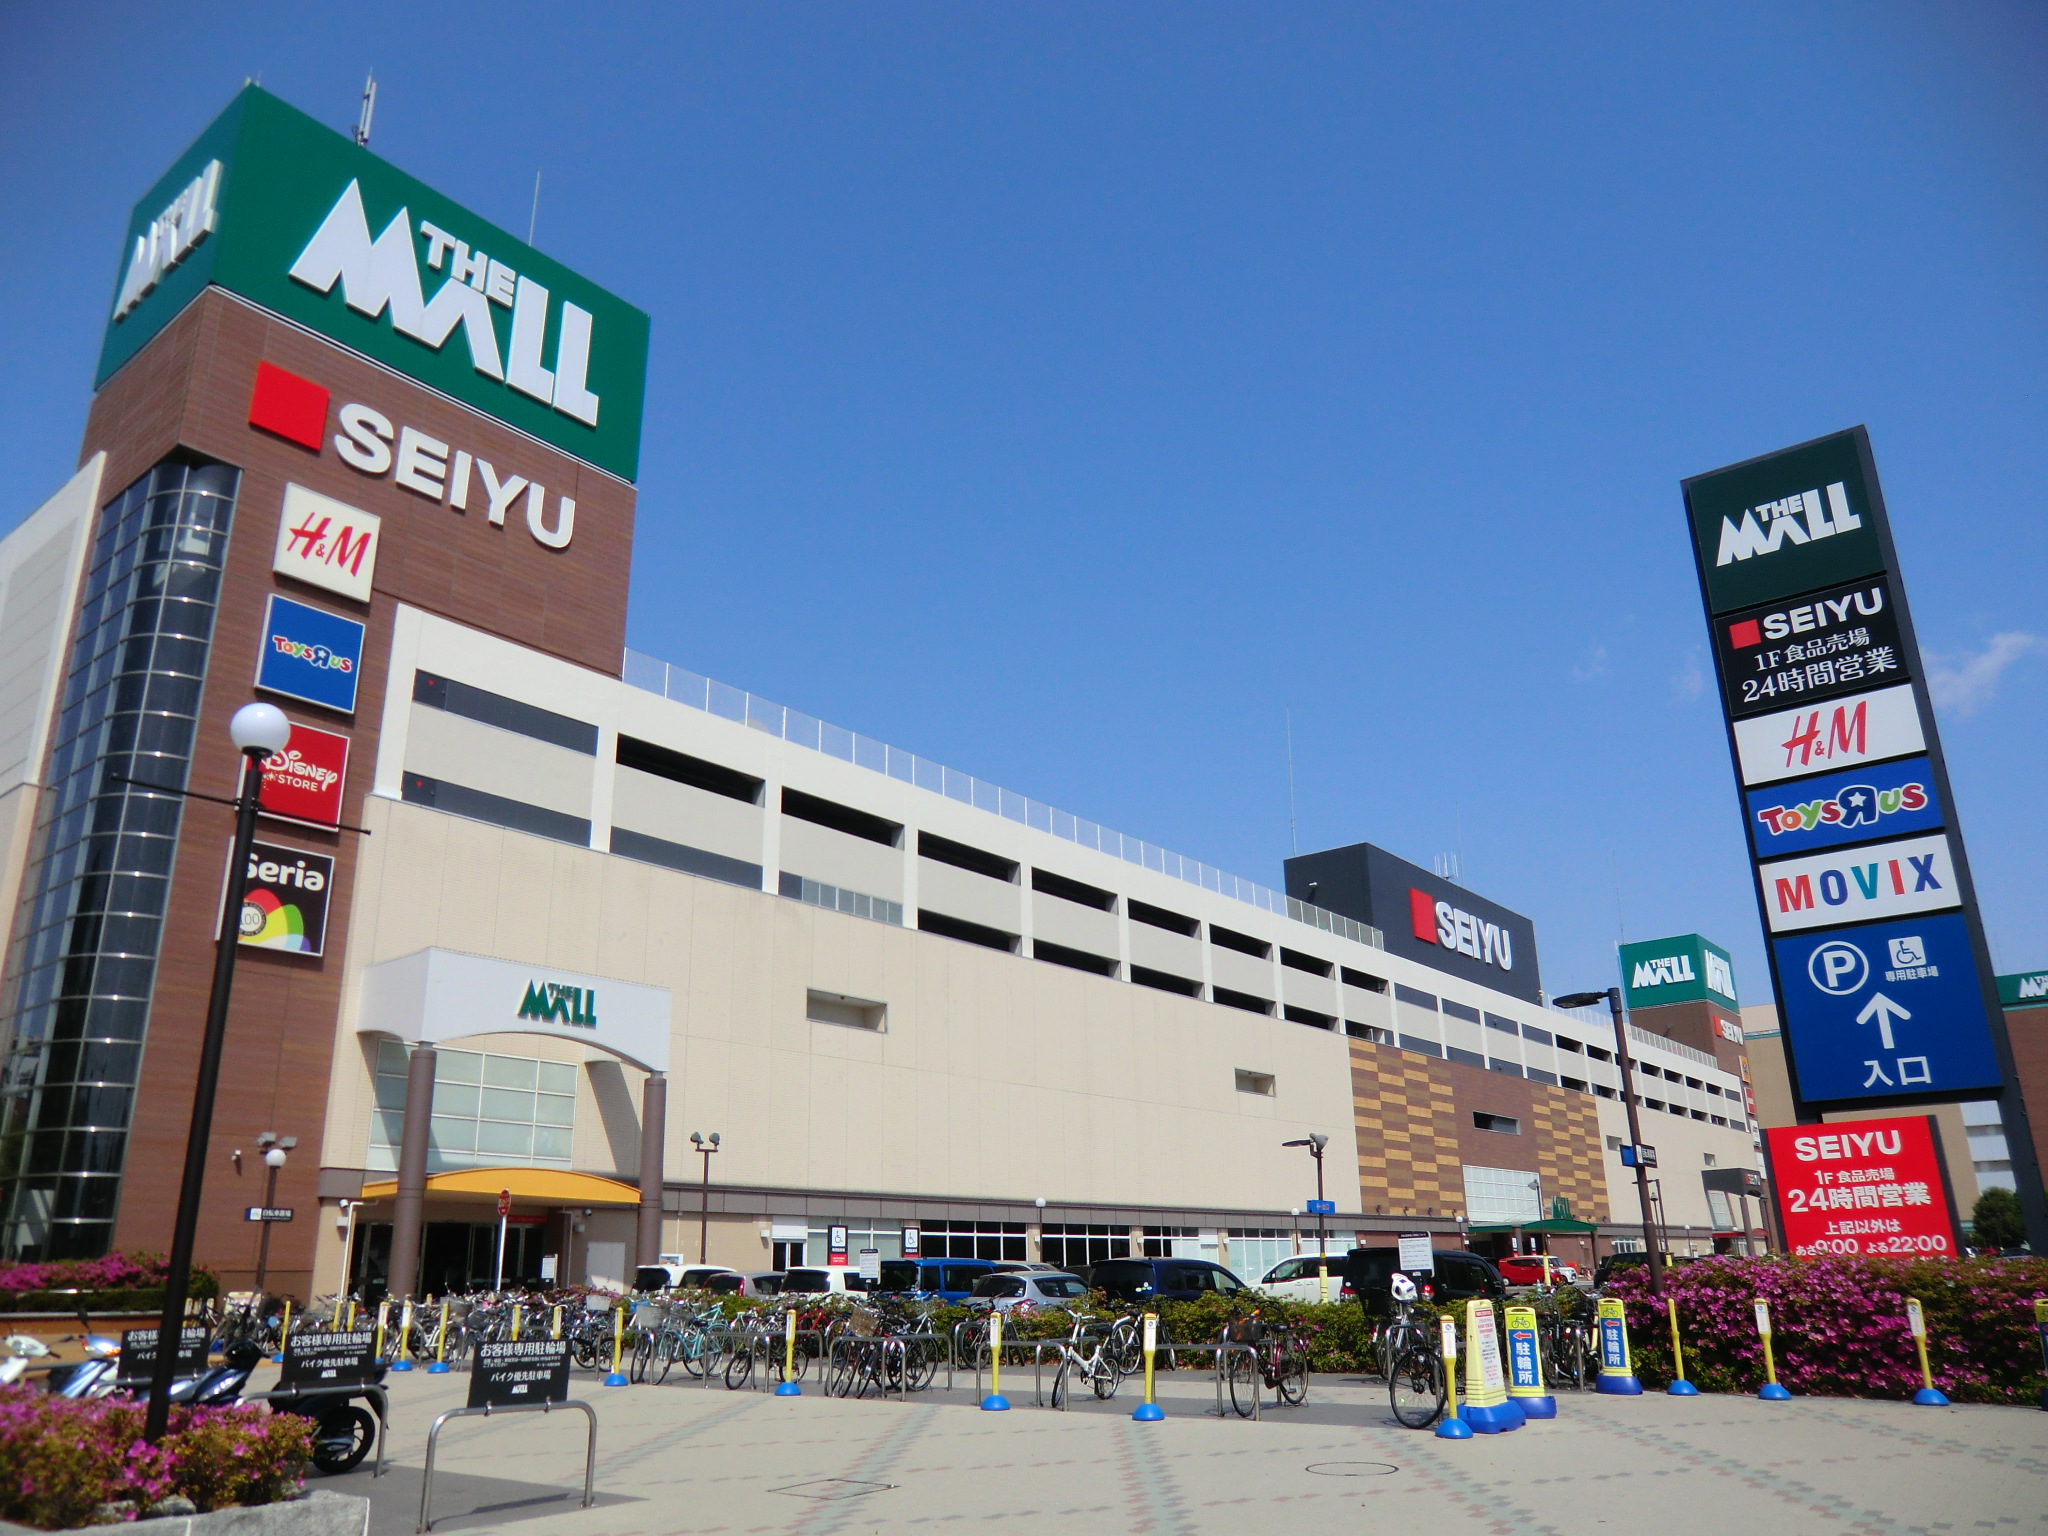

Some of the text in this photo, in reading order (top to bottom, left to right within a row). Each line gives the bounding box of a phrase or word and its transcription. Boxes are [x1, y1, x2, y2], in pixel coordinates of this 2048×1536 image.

[421, 221, 515, 307] THE
[289, 178, 599, 428] MALL
[333, 402, 576, 549] SEIYU
[1716, 481, 1862, 567] MALL
[1755, 494, 1804, 522] THE
[288, 511, 373, 578] H&M
[1763, 587, 1884, 641] SEIYU
[1741, 646, 1898, 703] 24時間営業
[1781, 700, 1867, 768] H&M
[278, 774, 318, 792] STORE
[1775, 853, 1942, 913] MOVIX
[1435, 901, 1512, 971] SEIYU
[1632, 955, 1695, 989] MALL
[1650, 957, 1671, 969] THE
[1885, 965, 1939, 982] 専用駐車場
[517, 978, 597, 1028] MALL
[547, 982, 574, 1001] THE
[1863, 1056, 1932, 1088] 入口
[1795, 1130, 1901, 1162] SEIYU
[1788, 1182, 1931, 1213] 24時間営業
[1825, 1219, 1902, 1235] 上記以外は
[290, 1332, 372, 1347] お客様専用駐輪場
[480, 1341, 566, 1357] お客様専用駐輪場
[1515, 1342, 1533, 1384] 駐輪所
